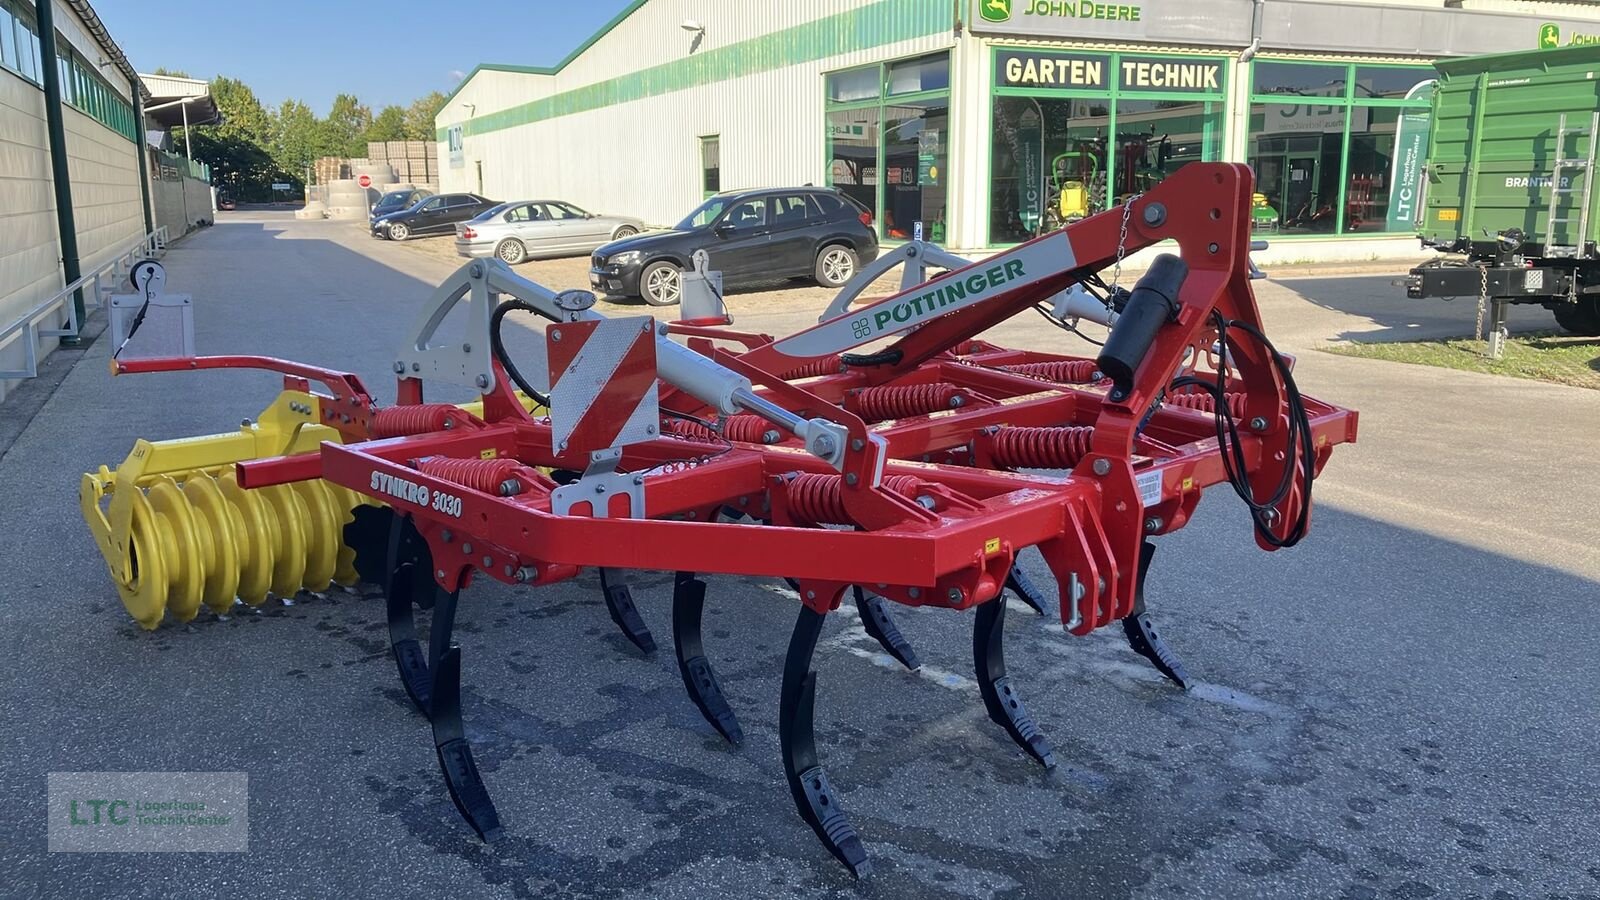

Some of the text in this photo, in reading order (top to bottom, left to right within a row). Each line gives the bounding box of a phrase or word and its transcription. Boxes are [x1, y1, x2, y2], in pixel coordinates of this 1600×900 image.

[1024, 0, 1141, 21] JOHN DEERE
[1006, 57, 1218, 88] GARTEN TECHNIK
[1402, 148, 1412, 186] Lagerhaus
[1505, 177, 1568, 188] BRANTNR
[1397, 188, 1412, 221] LTC
[874, 258, 1026, 331] PÖTTINGER
[370, 471, 462, 518] SYNKRO 3030
